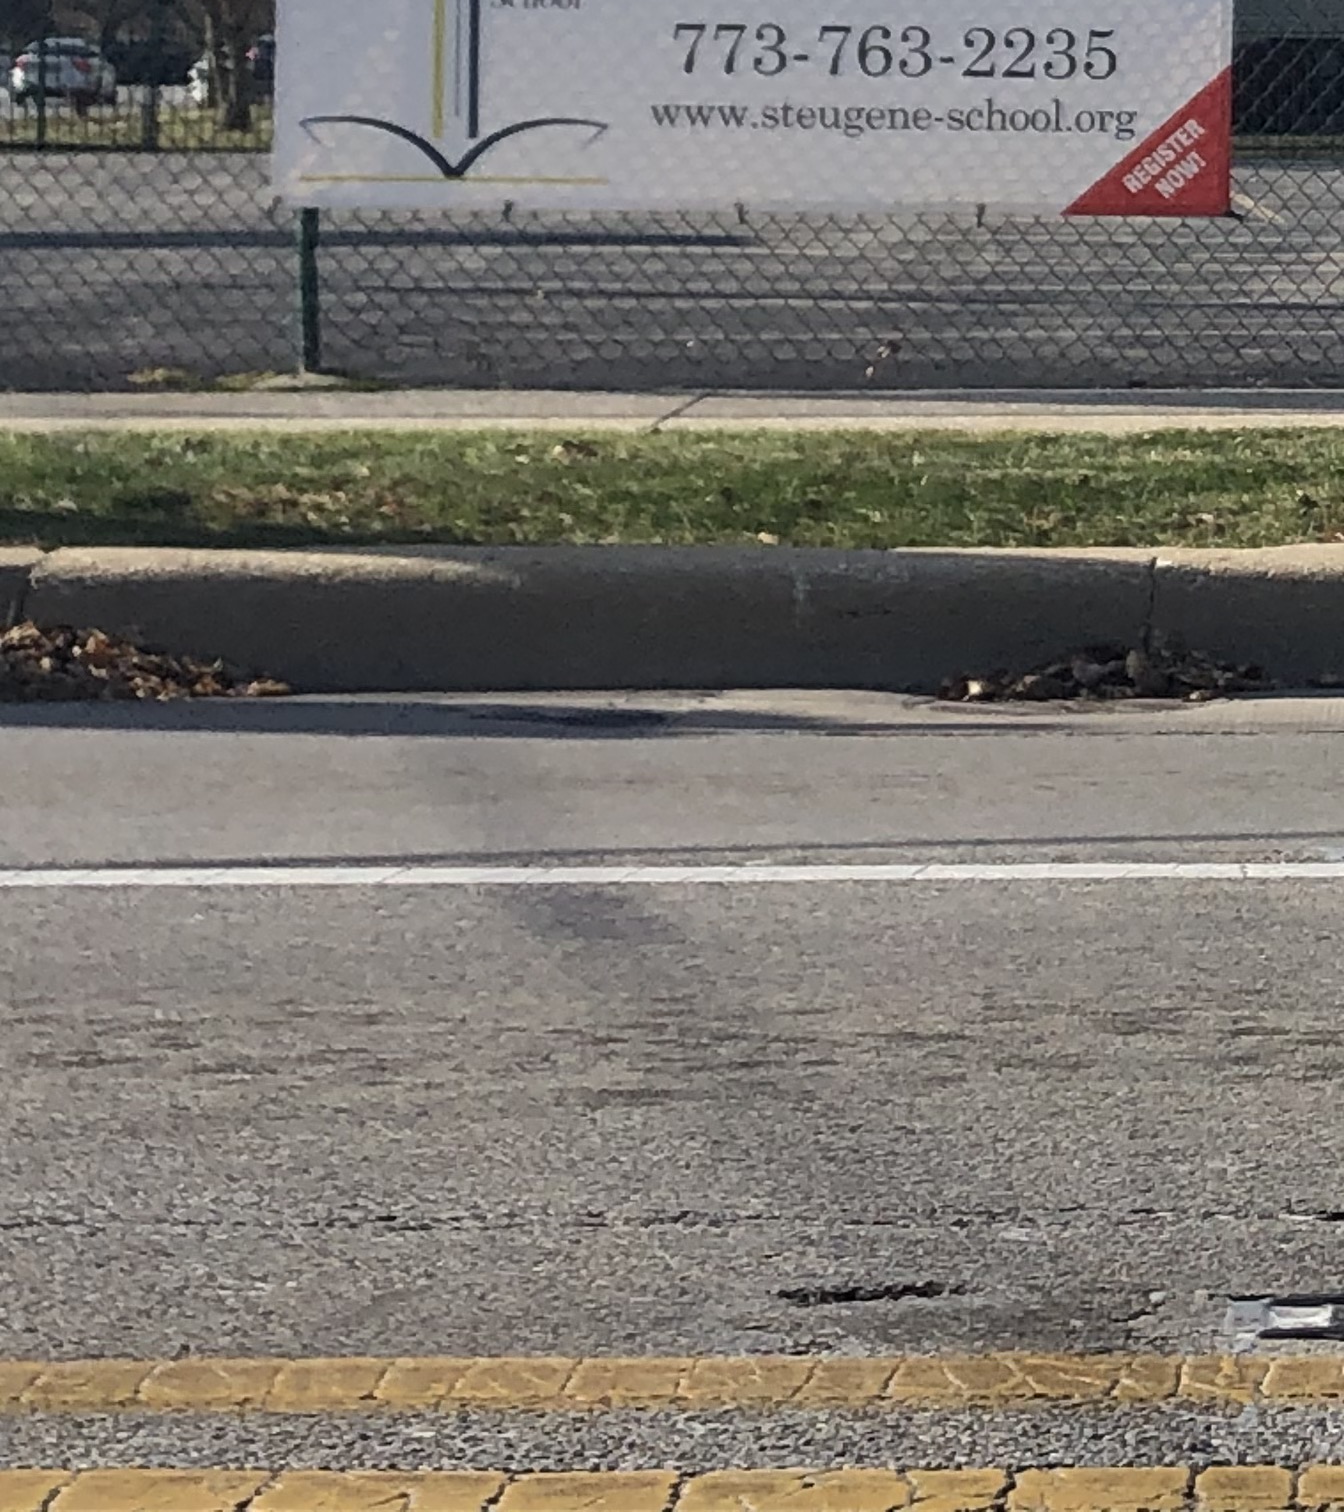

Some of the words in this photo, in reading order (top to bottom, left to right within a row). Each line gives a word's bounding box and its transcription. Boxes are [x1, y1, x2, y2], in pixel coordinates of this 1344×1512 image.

[673, 22, 1118, 81] 773-763-2235
[650, 97, 1138, 141] www.steugene-school.org
[1122, 119, 1206, 194] REGISTER
[1154, 151, 1207, 199] NOW!
